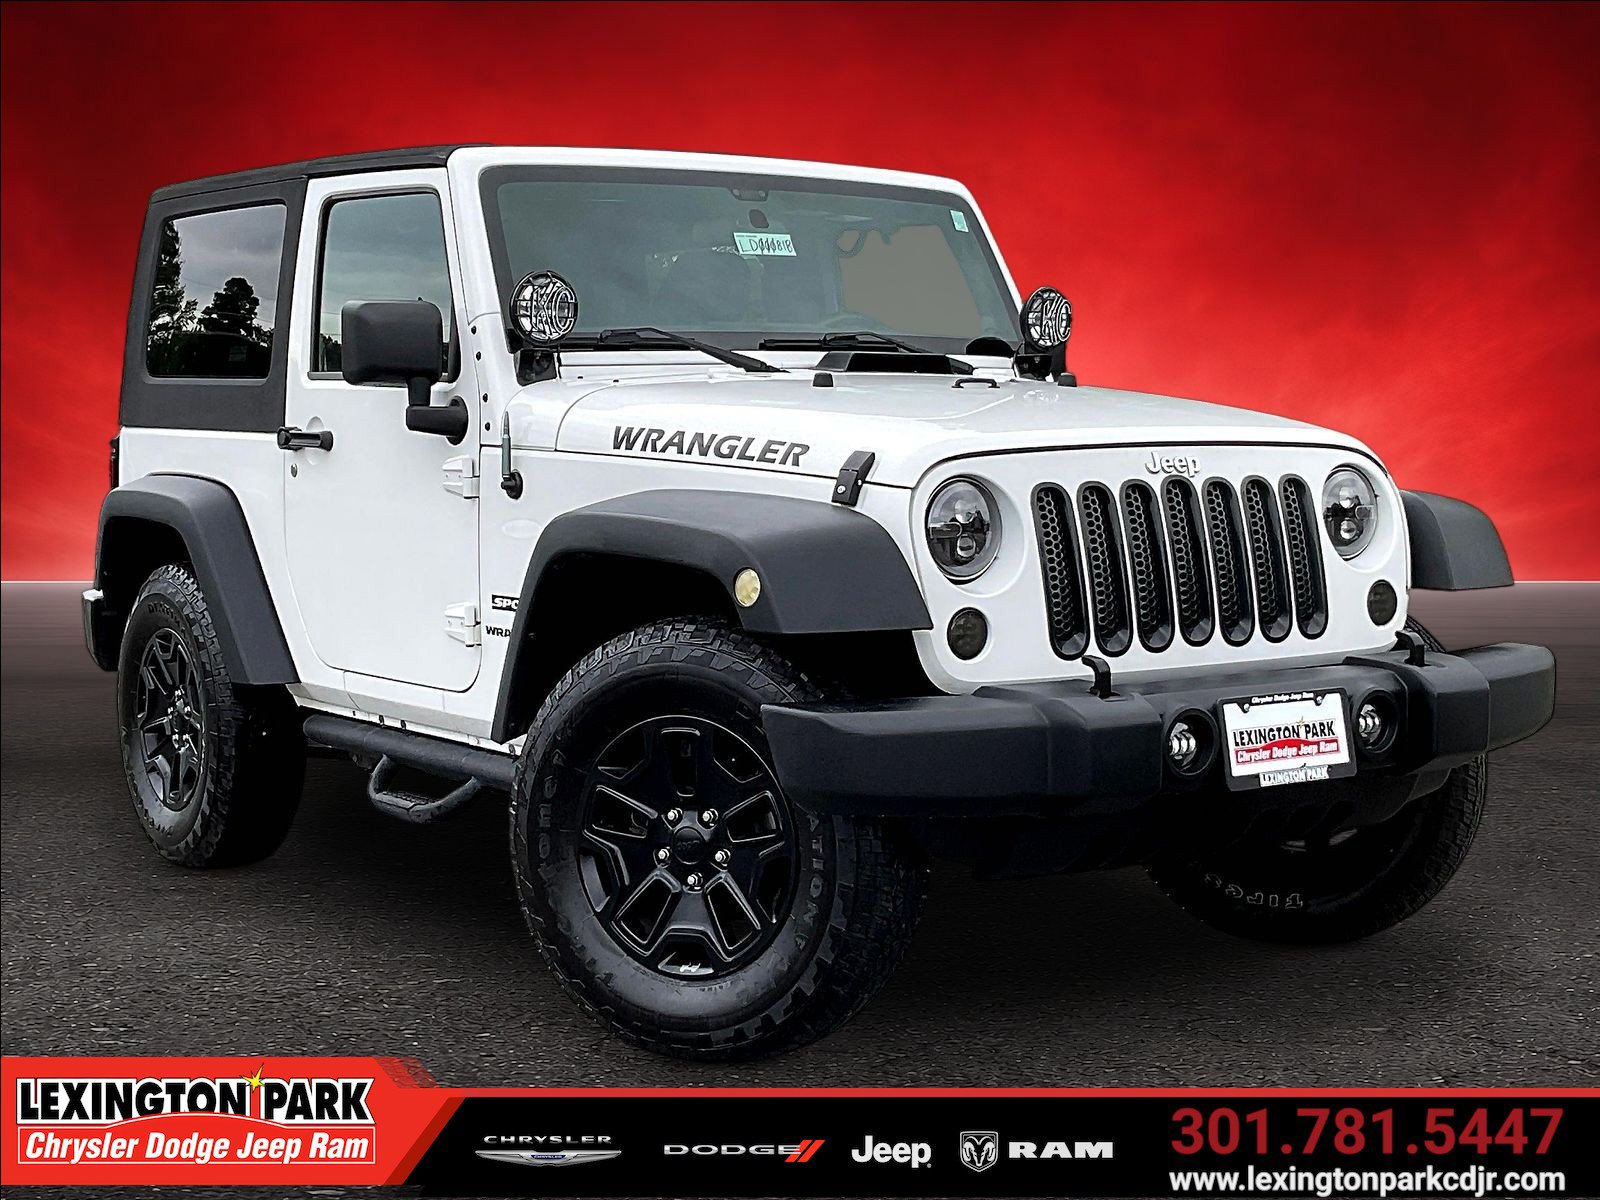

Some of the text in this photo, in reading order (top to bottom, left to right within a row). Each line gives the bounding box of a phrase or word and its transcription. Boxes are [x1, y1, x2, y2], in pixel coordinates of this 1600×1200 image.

[612, 425, 810, 467] WRANGLER
[1144, 451, 1201, 478] Jeep
[1233, 720, 1336, 747] LEXINGTON PARK
[1237, 741, 1338, 763] Chrysler Dodge Jeep Ram
[1261, 766, 1329, 785] LEXINGTON PARK
